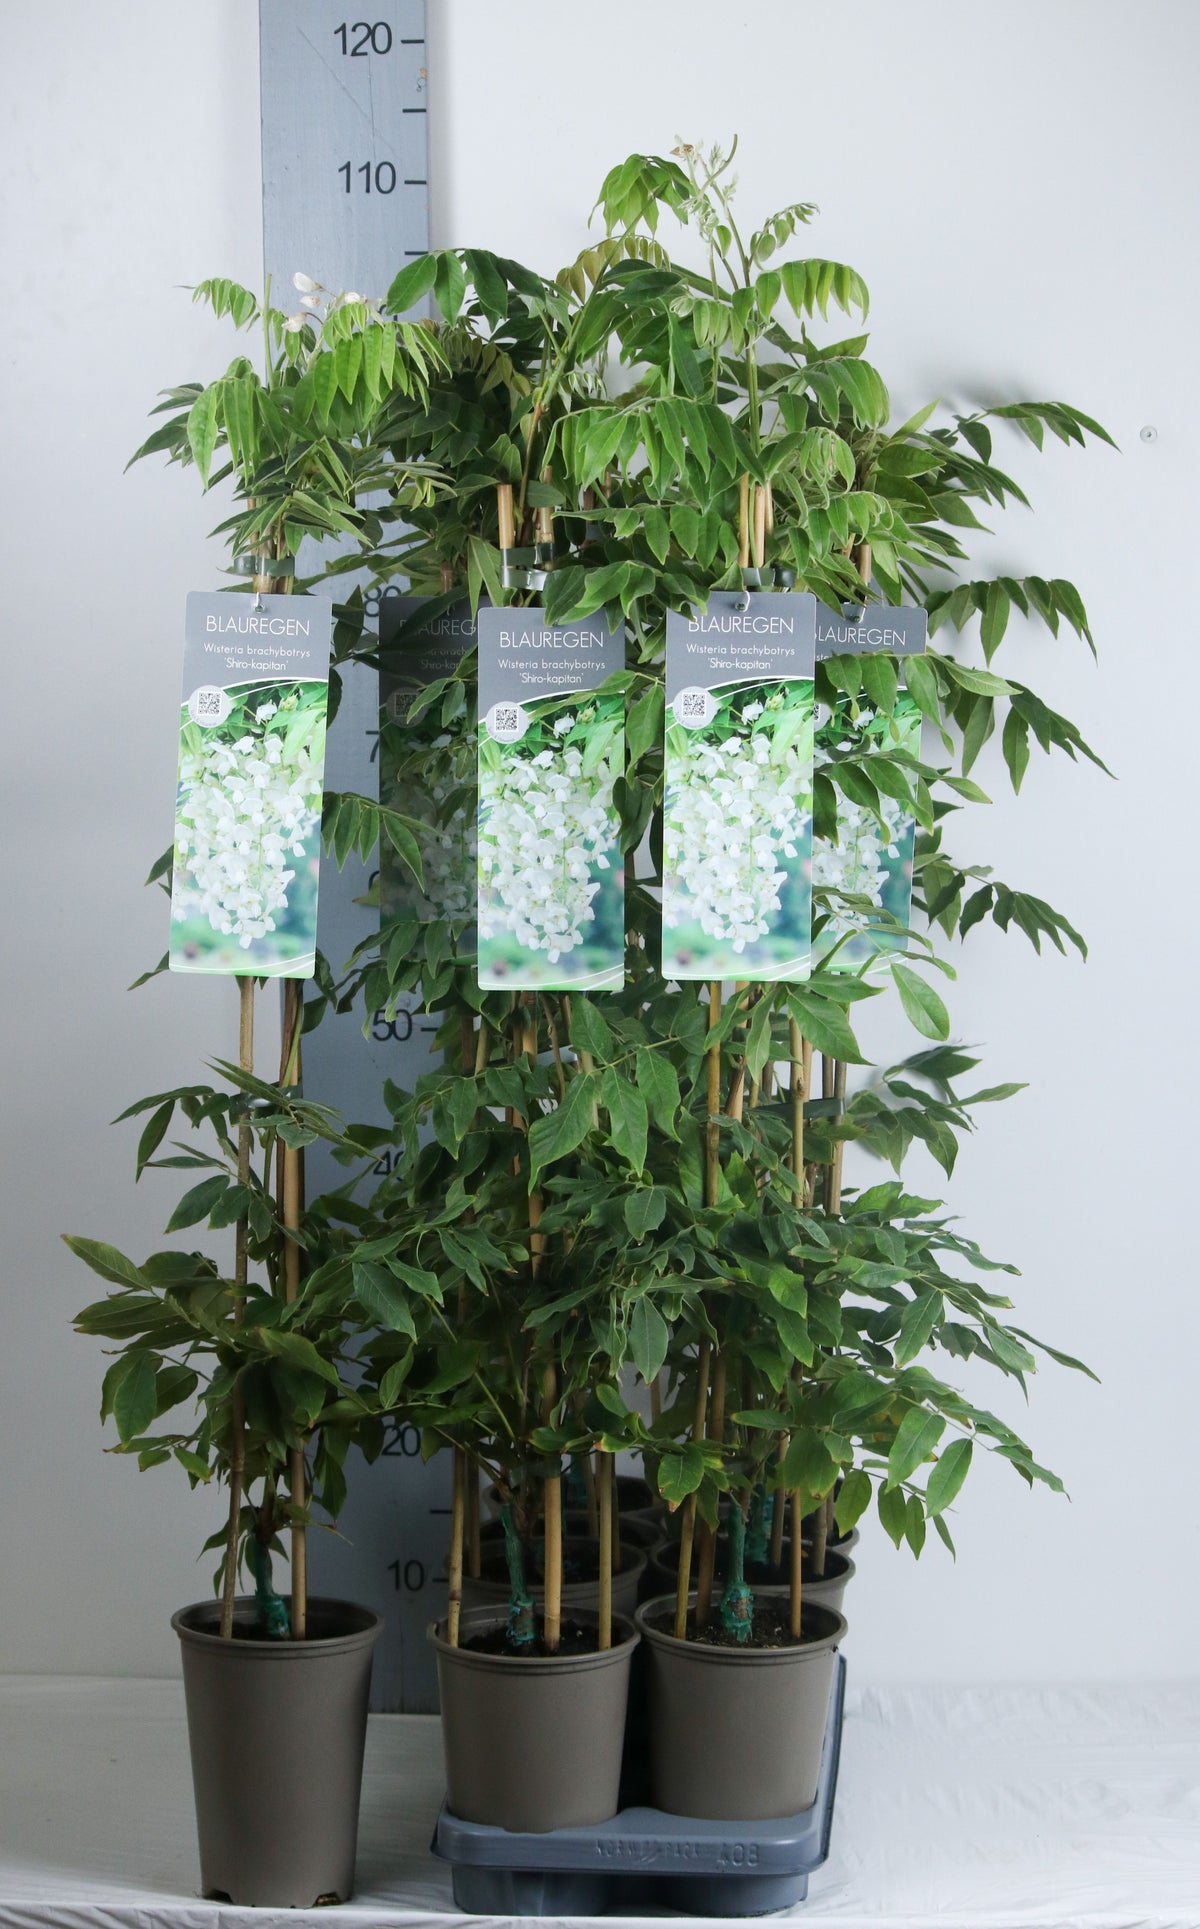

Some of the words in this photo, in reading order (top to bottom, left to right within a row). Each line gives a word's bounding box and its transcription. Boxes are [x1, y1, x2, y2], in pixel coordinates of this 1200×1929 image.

[334, 22, 392, 57] 120
[338, 161, 396, 194] 110
[206, 615, 310, 636] BLAUREGEN
[688, 615, 794, 634] BLAUREGEN
[500, 631, 604, 648] BLAUREGEN
[814, 625, 906, 646] LAUREGEN
[203, 642, 244, 655] Wisteria
[247, 644, 311, 660] brachybotrys
[686, 643, 727, 654] Wisteria
[730, 643, 796, 657] brachybotrys
[498, 658, 539, 669] Wisteria
[541, 658, 606, 672] brachybotrys
[372, 1008, 413, 1041] 50
[381, 1425, 421, 1457] 20
[387, 1559, 425, 1592] 10
